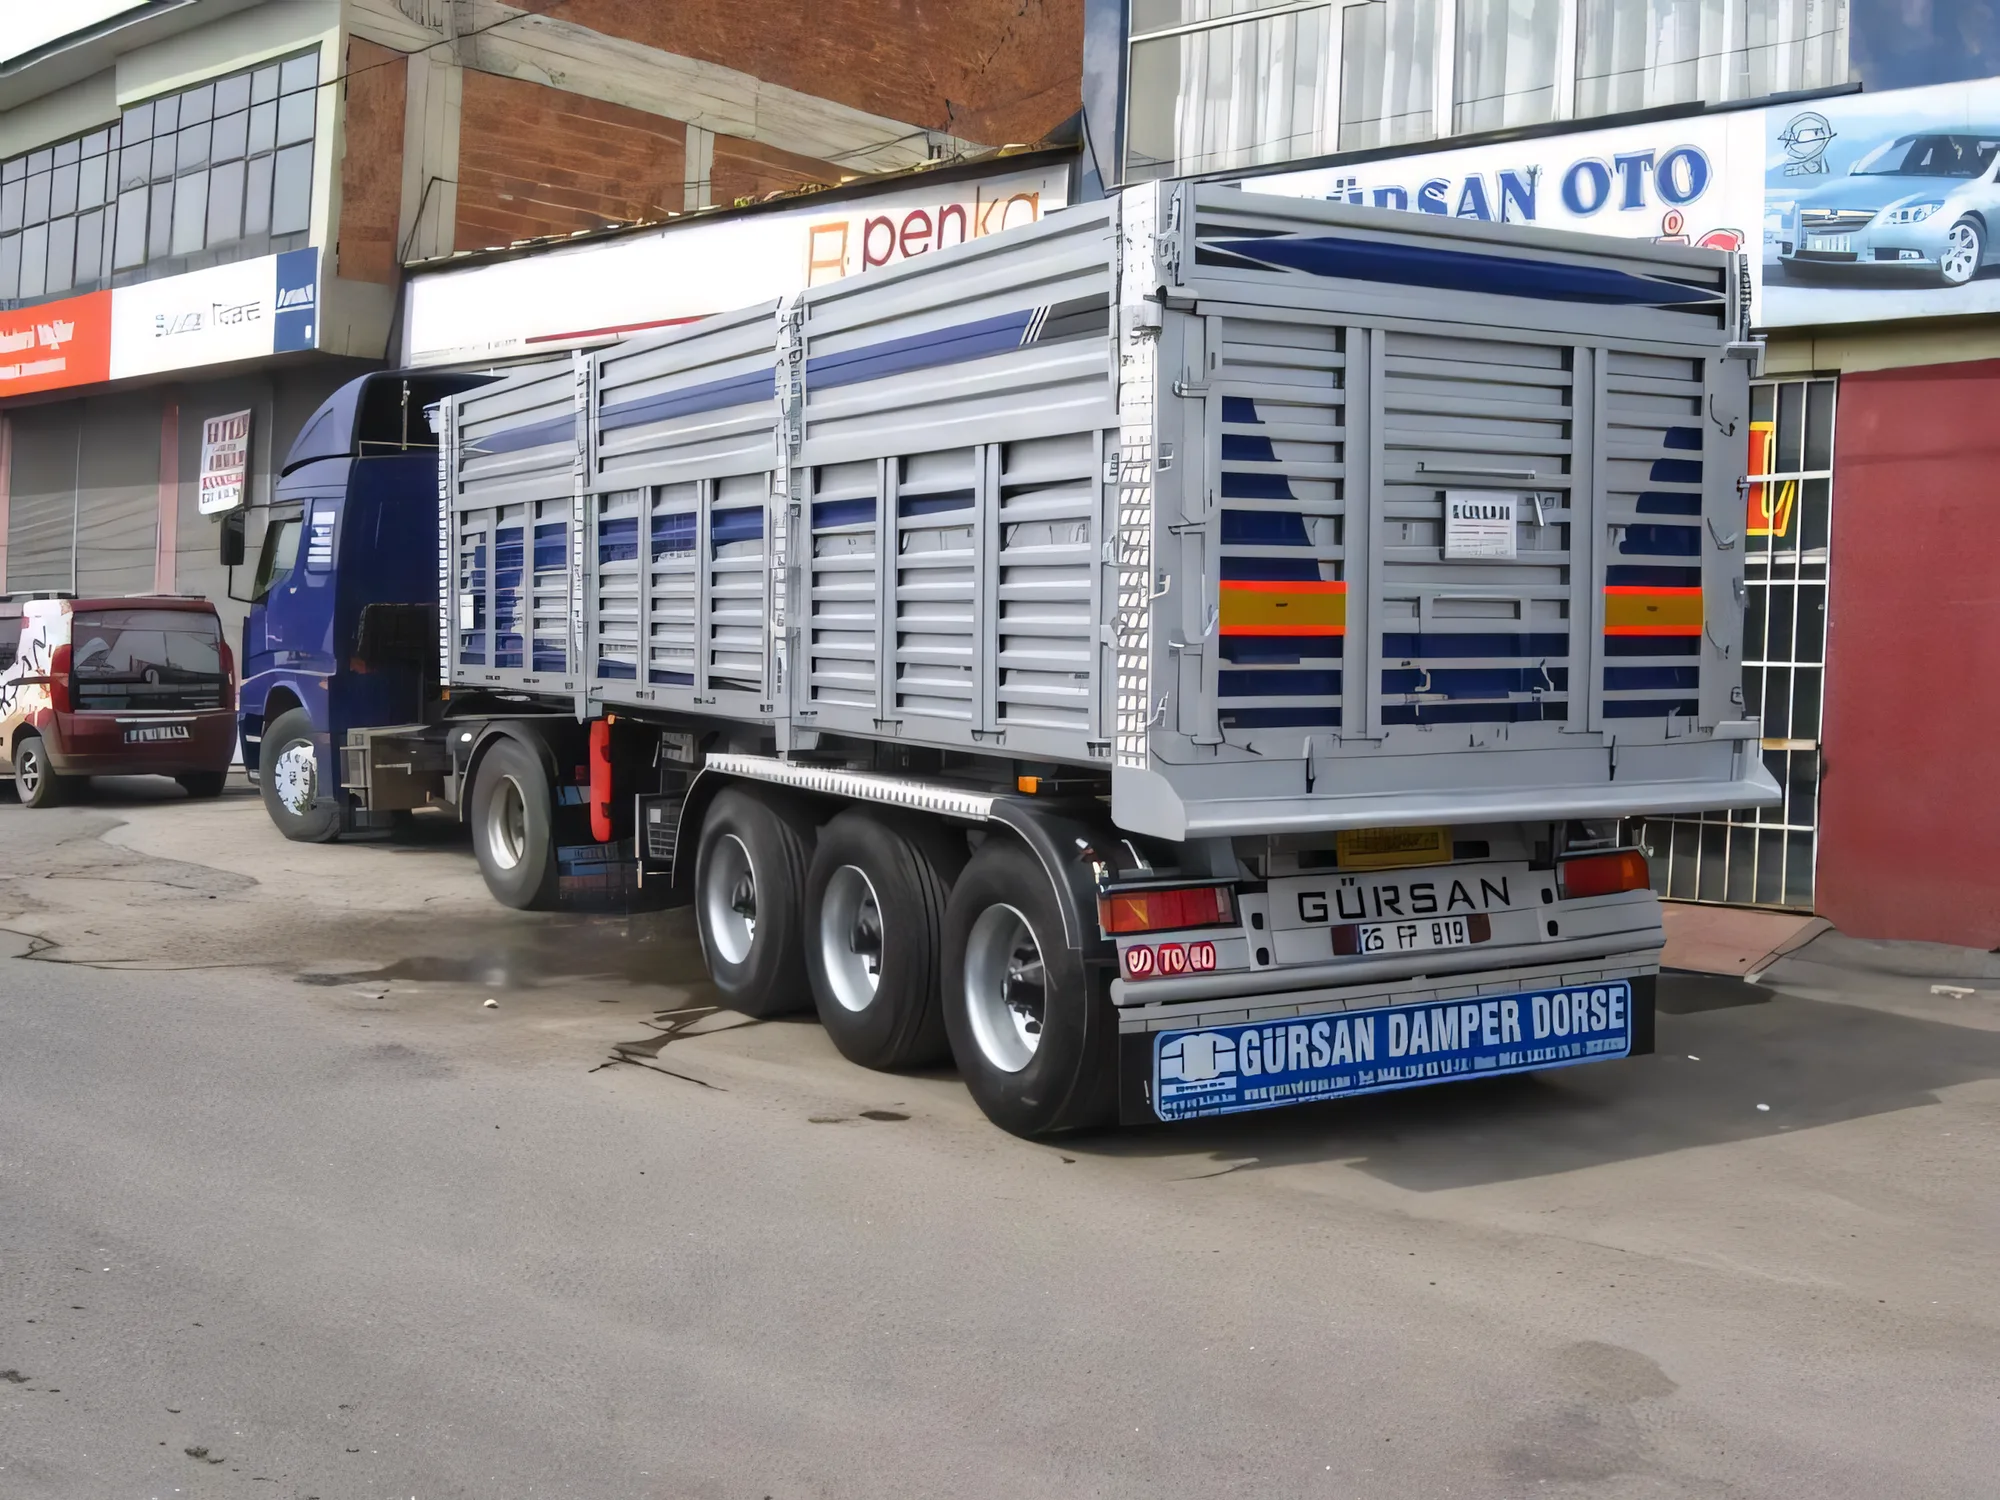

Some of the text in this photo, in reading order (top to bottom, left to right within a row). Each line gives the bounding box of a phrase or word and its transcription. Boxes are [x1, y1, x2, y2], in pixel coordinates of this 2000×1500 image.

[1561, 146, 1712, 216] OTO
[1297, 876, 1511, 923] GÜRSAN
[1239, 1016, 1375, 1077] GÜRSAN
[1388, 1000, 1522, 1057] DAMPER
[1531, 987, 1625, 1039] DORSE
